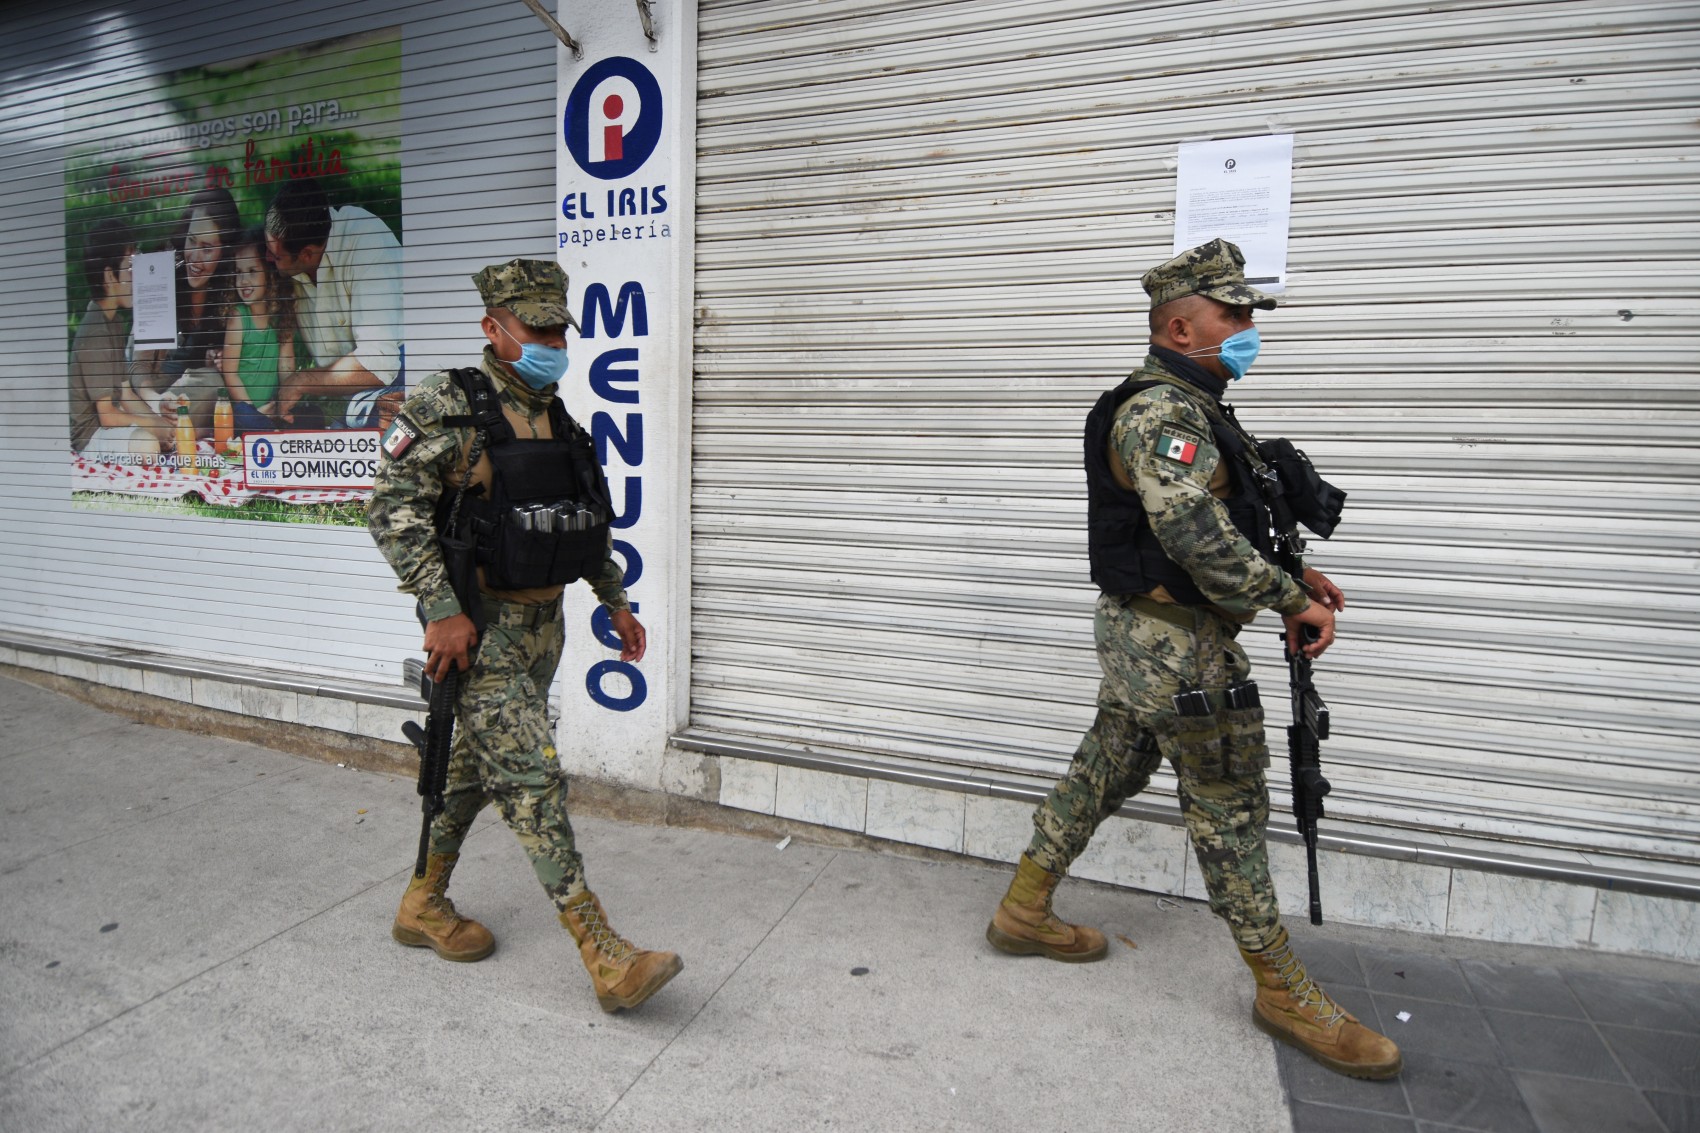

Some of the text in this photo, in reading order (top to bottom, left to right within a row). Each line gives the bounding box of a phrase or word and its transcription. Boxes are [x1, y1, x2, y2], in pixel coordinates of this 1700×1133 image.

[241, 109, 281, 134] son
[205, 164, 235, 189] en
[243, 137, 349, 189] familia
[562, 184, 668, 220] EL IRIS
[558, 220, 672, 248] papelería
[280, 438, 377, 454] CERRADO LOS
[146, 455, 153, 465] a
[155, 451, 166, 466] lo
[169, 455, 191, 471] que
[195, 455, 226, 468] amas
[282, 460, 377, 479] DOMINGOS
[251, 470, 277, 479] EL IRIS
